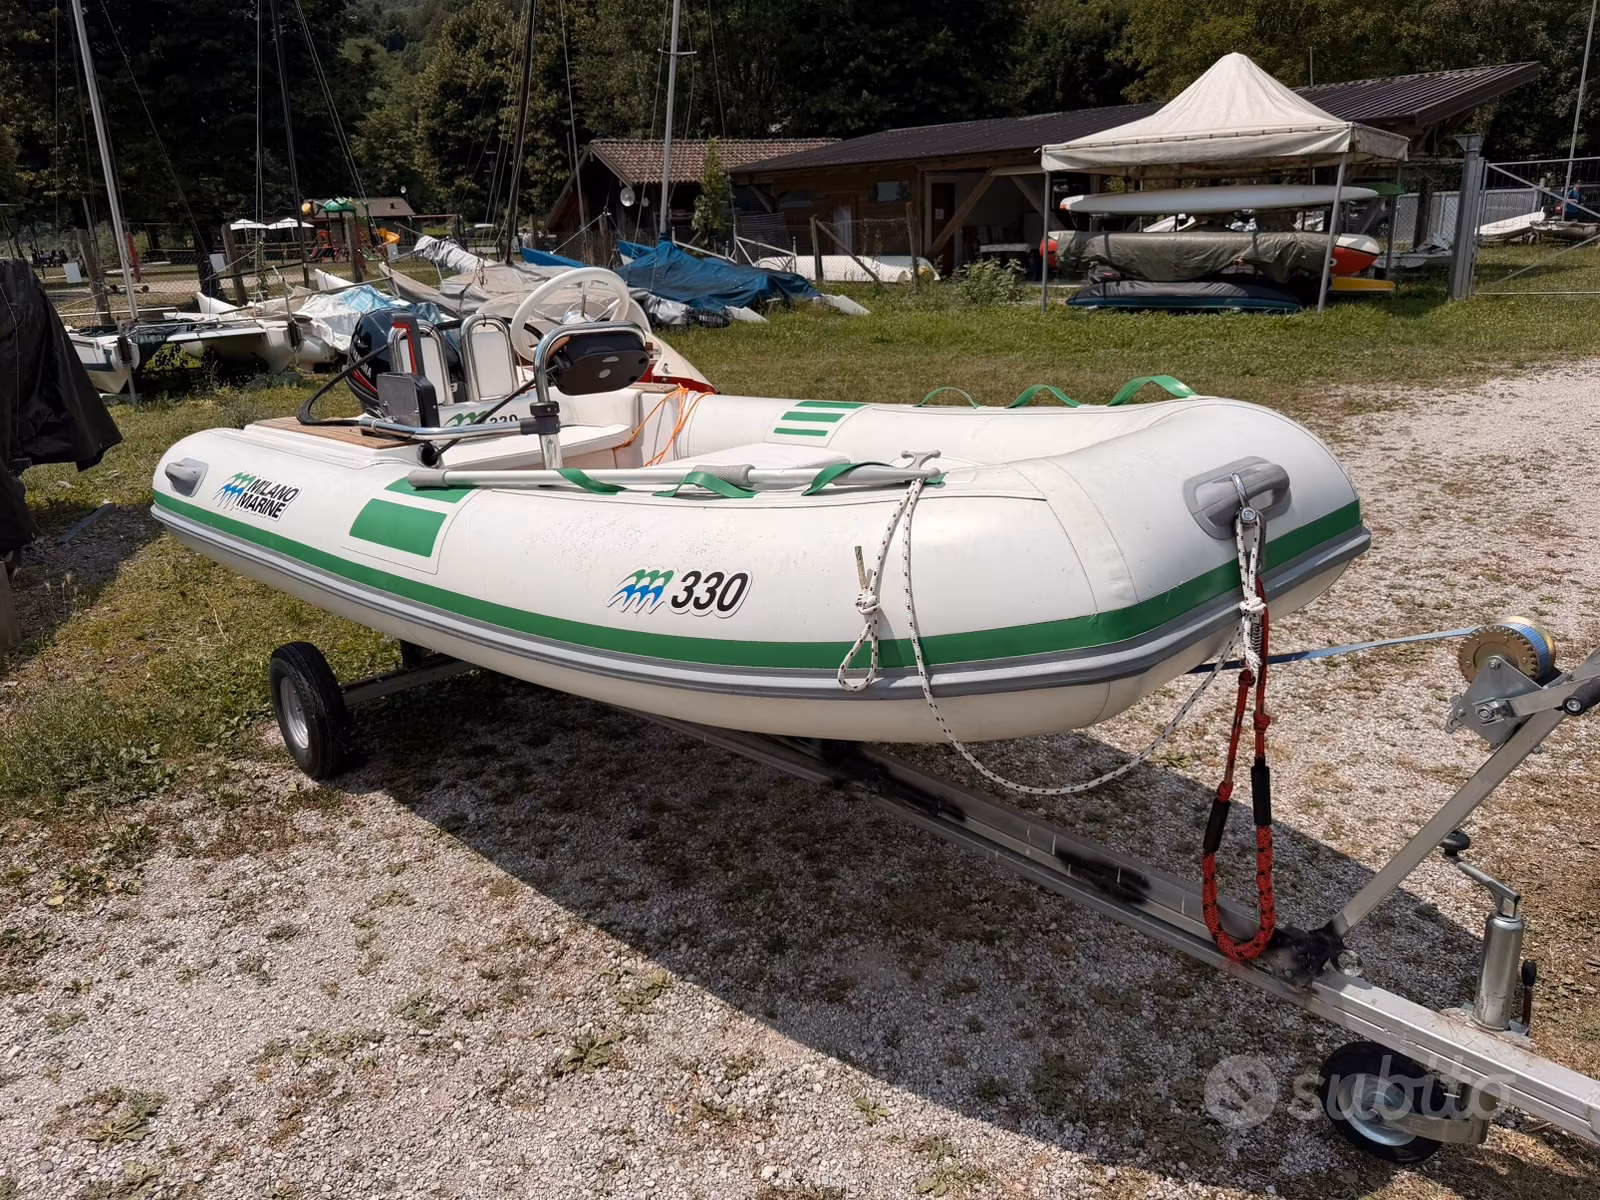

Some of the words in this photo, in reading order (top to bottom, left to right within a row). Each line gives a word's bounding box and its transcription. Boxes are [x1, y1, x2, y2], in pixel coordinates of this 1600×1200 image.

[247, 478, 300, 503] MILANO
[236, 492, 287, 519] MARINE
[671, 570, 749, 612] 330
